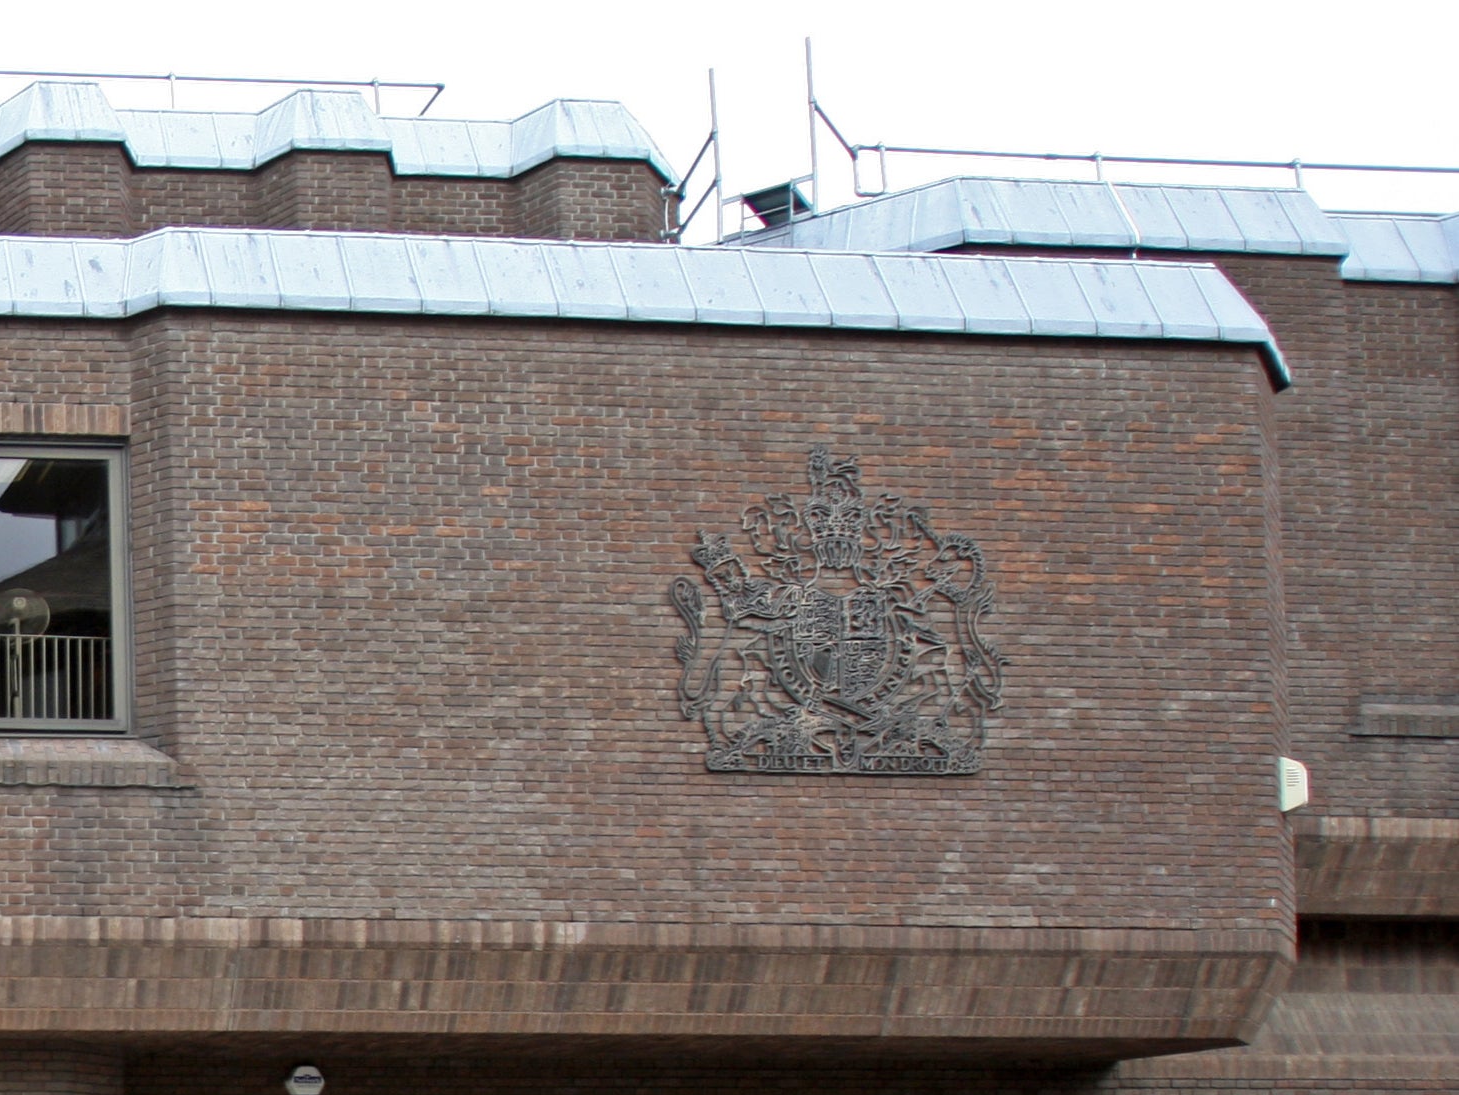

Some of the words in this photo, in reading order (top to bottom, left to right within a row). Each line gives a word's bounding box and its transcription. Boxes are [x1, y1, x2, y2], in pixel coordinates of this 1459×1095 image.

[757, 755, 797, 769] DIEU
[803, 757, 824, 769] ET
[860, 757, 898, 771] MON
[901, 757, 948, 771] DROIT
